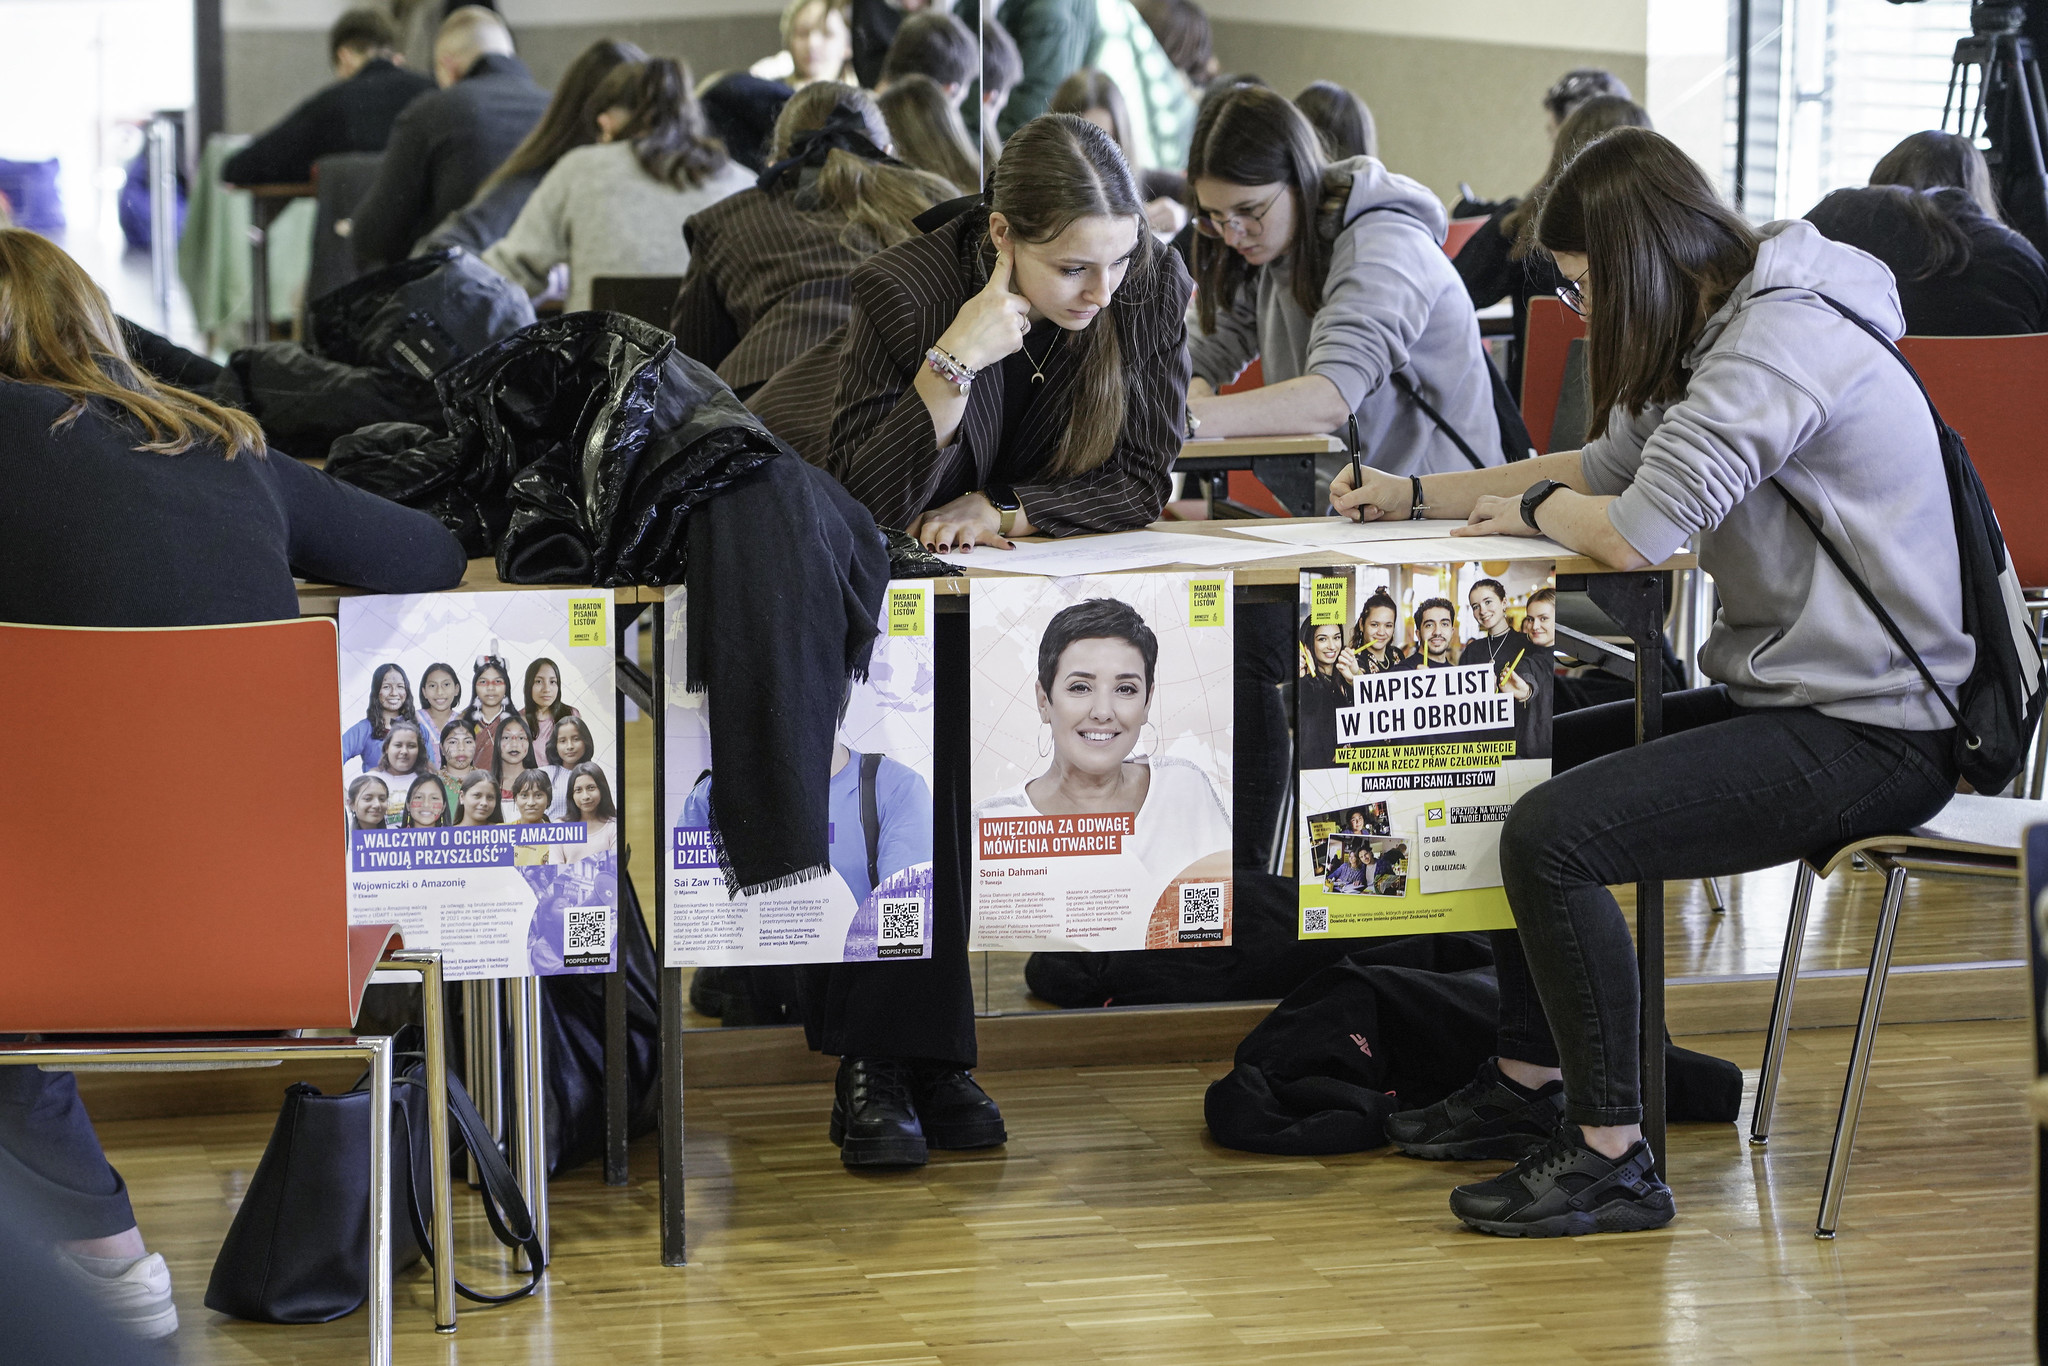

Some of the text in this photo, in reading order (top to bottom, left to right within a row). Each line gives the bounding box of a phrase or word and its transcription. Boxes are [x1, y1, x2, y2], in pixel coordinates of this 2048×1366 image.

[894, 607, 915, 615] LISTÓW
[1360, 670, 1489, 704] NAPISZ LIST
[1341, 699, 1508, 737] W ICH OBRONIE
[1338, 742, 1513, 760] WEŹ UDZIAŁ W NAJWIĘKSZEJ NA ŚWIECIE
[1351, 755, 1499, 772] AKCJI NA RZECZ PRAW CZŁOWIEKA
[1364, 771, 1494, 791] MARATON PISANIA LISTÓW
[1452, 807, 1478, 815] PRZYJDŹ
[1489, 805, 1512, 813] WYDAR
[441, 831, 449, 845] O
[454, 829, 516, 846] OCHRONĘ
[520, 826, 583, 842] AMAZONII
[983, 817, 1130, 839] UWIĘZIONA ZA ODWAGĘ
[678, 831, 711, 849] UWIĘ
[983, 836, 1116, 855] MÓWIENIA OTWARCIE
[361, 853, 364, 867] I
[369, 851, 412, 869] TWOJĄ
[678, 849, 716, 864] DZIEN
[980, 867, 1048, 878] Sonia Dahmani
[352, 880, 409, 892] Wojowniczki
[421, 878, 466, 888] Amazonię
[674, 879, 688, 887] Sai
[692, 878, 710, 887] Zaw
